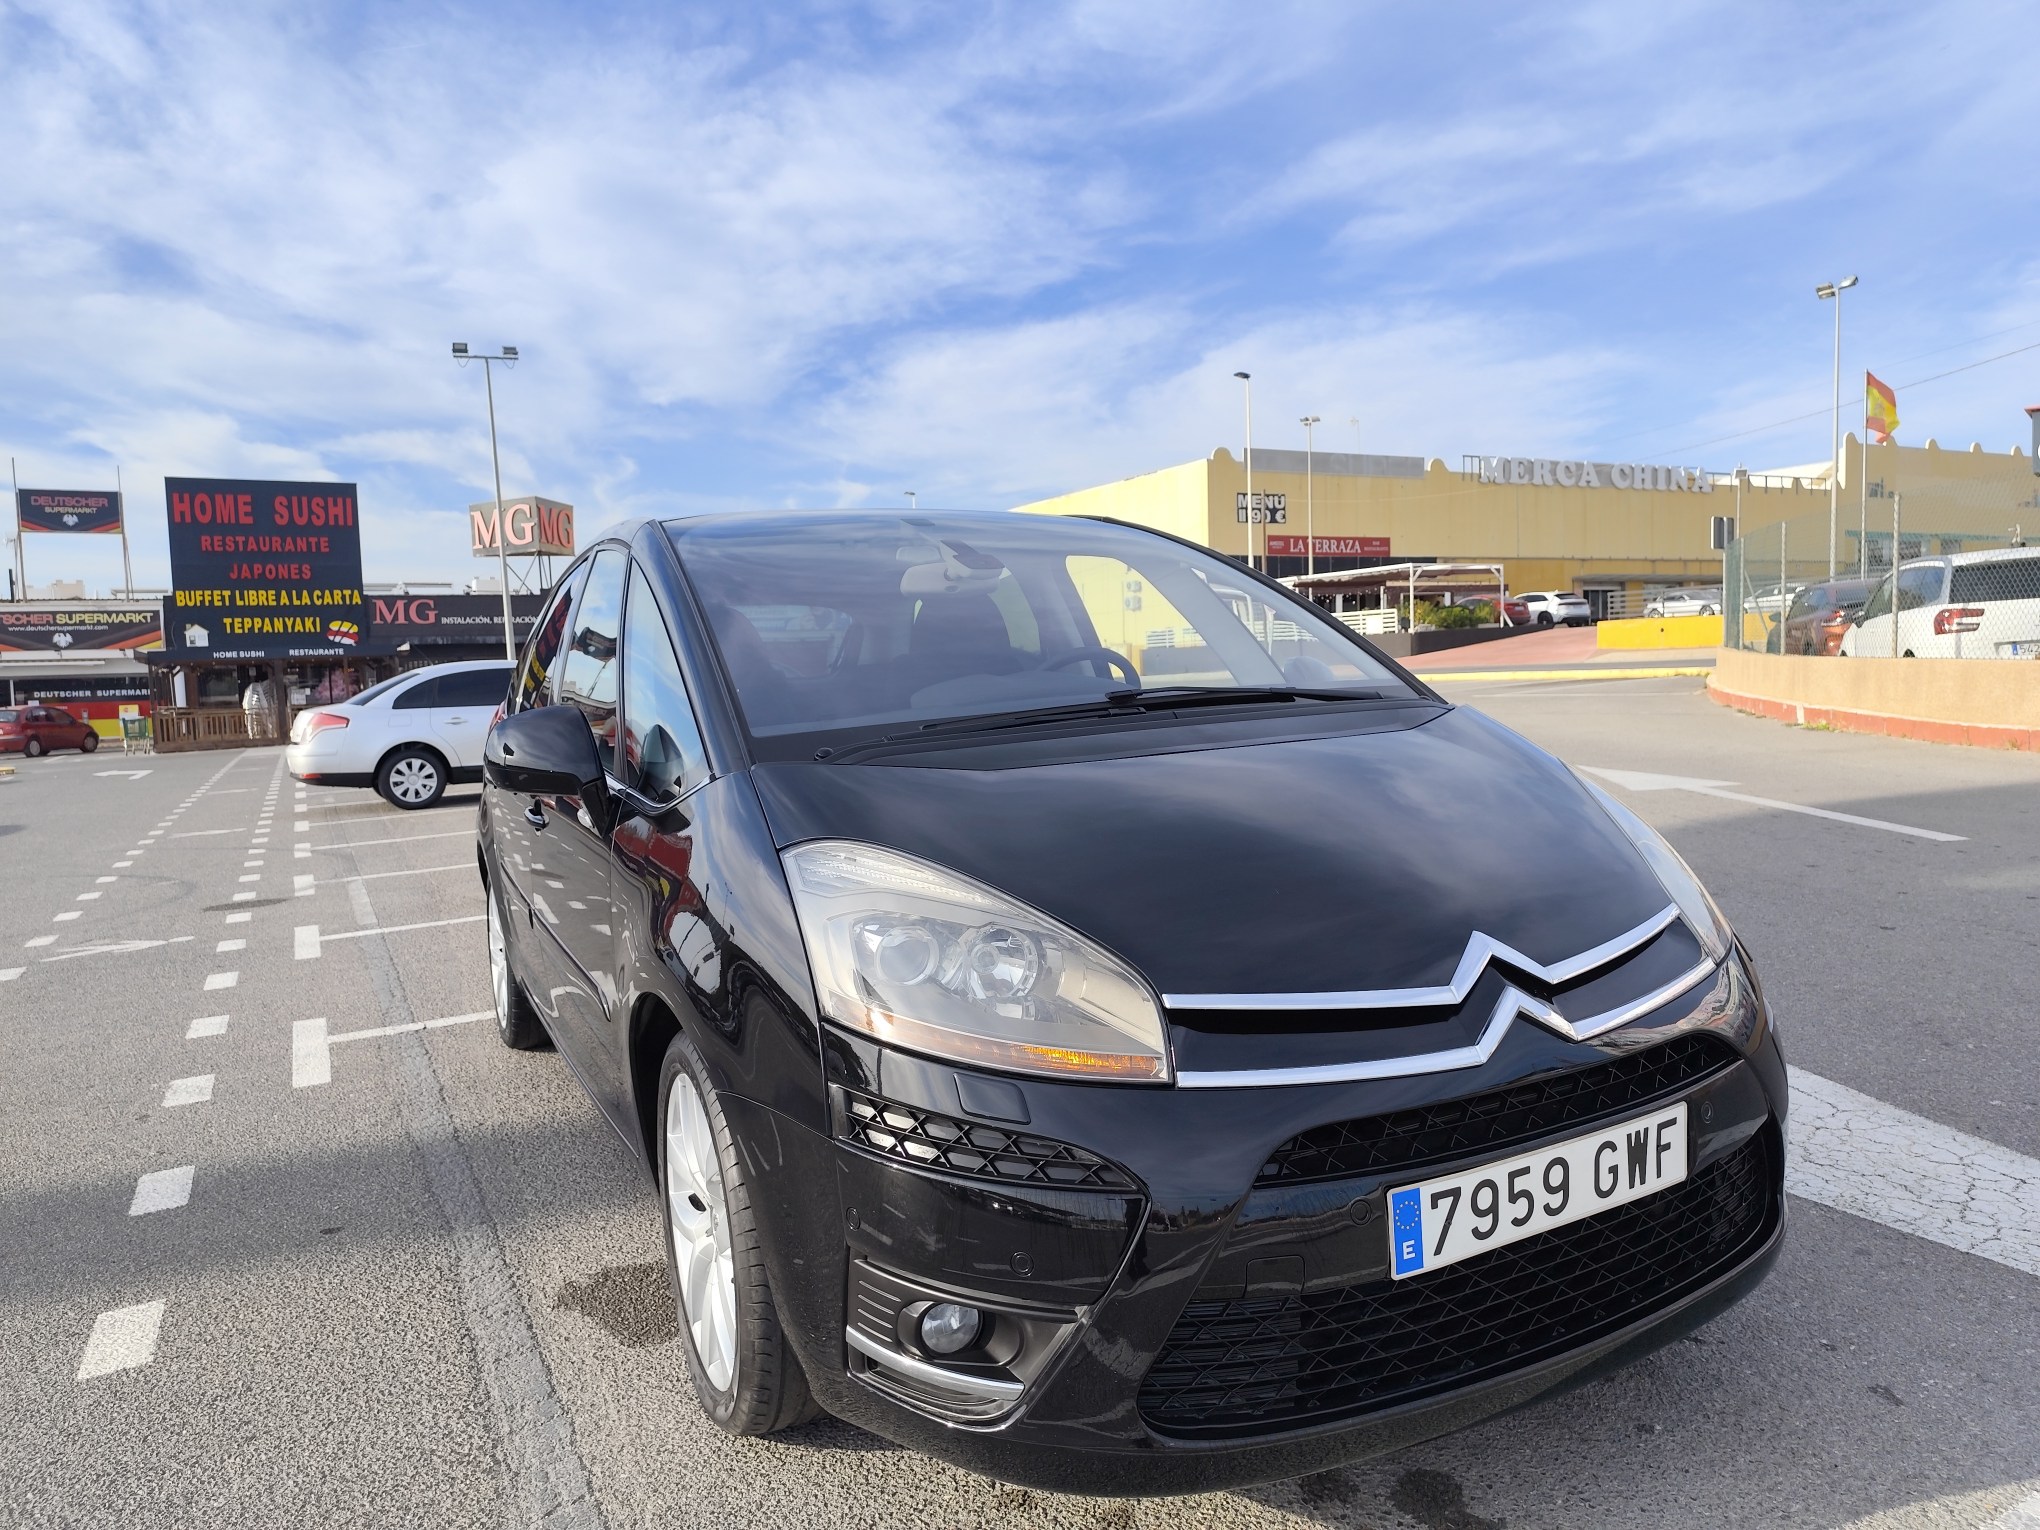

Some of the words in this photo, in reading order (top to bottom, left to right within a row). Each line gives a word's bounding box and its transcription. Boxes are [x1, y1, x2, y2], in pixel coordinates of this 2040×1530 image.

[1480, 456, 1600, 488] MERCA
[1611, 462, 1713, 493] CHINA
[30, 496, 109, 507] DEUTSCHER
[44, 506, 97, 514] SUPERMARKT
[172, 492, 254, 524] HOME
[274, 495, 353, 527] SUSHI
[470, 503, 536, 550] MG
[536, 504, 573, 549] MG
[201, 535, 330, 552] RESTAURANTE
[1289, 538, 1305, 552] LA
[229, 563, 312, 580] JAPONES
[175, 590, 231, 607] BUFFET
[235, 590, 277, 606] LIBRE
[280, 590, 290, 606] A
[292, 589, 311, 606] LA
[313, 589, 362, 606] CARTA
[56, 612, 154, 625] SUPERMARKT
[372, 598, 438, 625] MG
[8, 624, 109, 632] www.deutschersupermarkt.com
[223, 617, 321, 634] TEPPANYAKI
[213, 651, 238, 659] HOME
[239, 650, 265, 658] SUSHI
[289, 648, 344, 657] RESTAURANTE
[34, 690, 92, 698] DEUTSCHER
[1402, 1239, 1416, 1260] E
[1430, 1156, 1570, 1257] 7959
[1594, 1117, 1678, 1199] GWF
